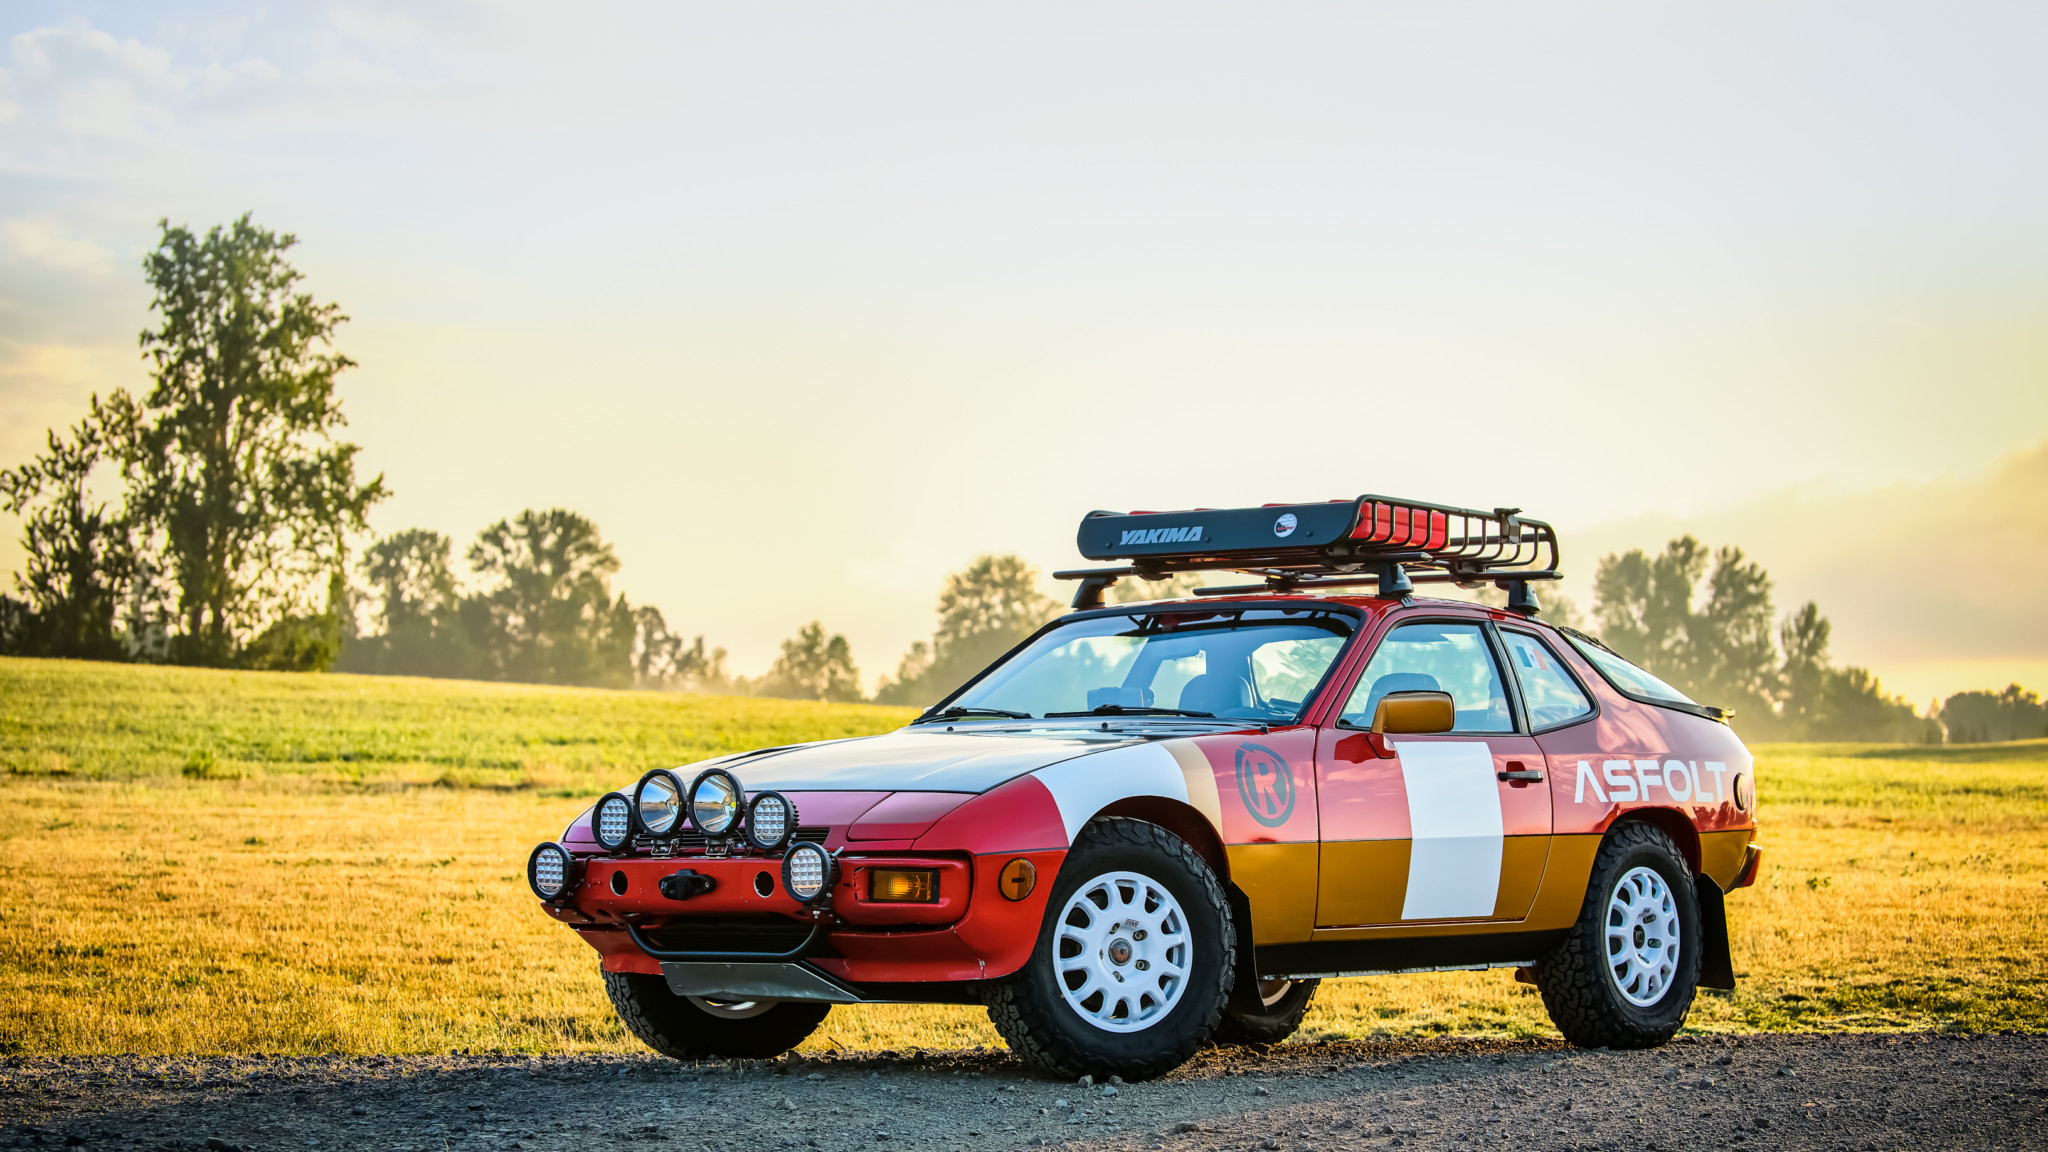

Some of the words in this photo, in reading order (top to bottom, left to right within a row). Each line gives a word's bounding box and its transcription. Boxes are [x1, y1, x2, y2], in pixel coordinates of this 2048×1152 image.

[1119, 526, 1203, 545] YAKIMA
[1244, 750, 1288, 818] R
[1574, 760, 1727, 803] ASFOLT
